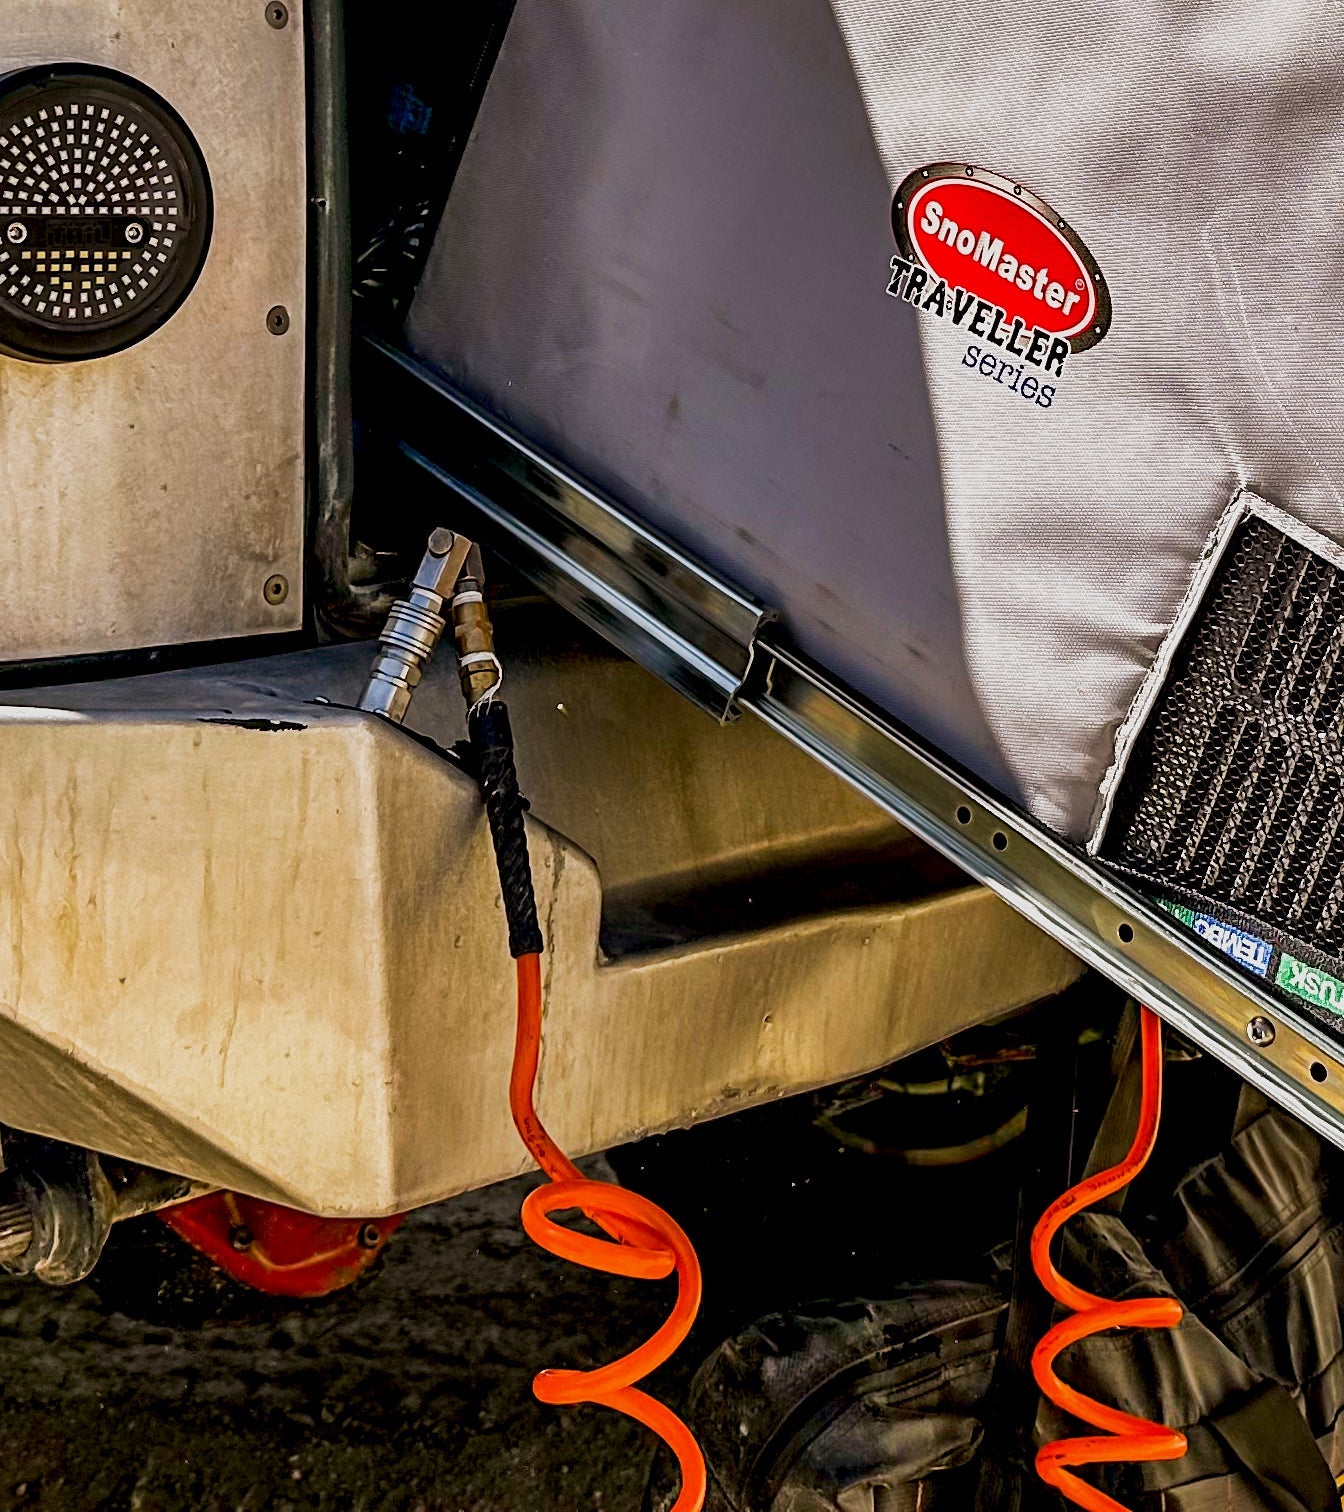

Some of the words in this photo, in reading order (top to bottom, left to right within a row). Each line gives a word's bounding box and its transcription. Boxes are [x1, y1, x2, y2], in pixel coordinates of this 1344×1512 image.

[920, 199, 1081, 317] SnoMaster
[885, 254, 1072, 378] TRAVELLER
[961, 345, 1057, 408] series
[1192, 918, 1269, 973] TEMBO
